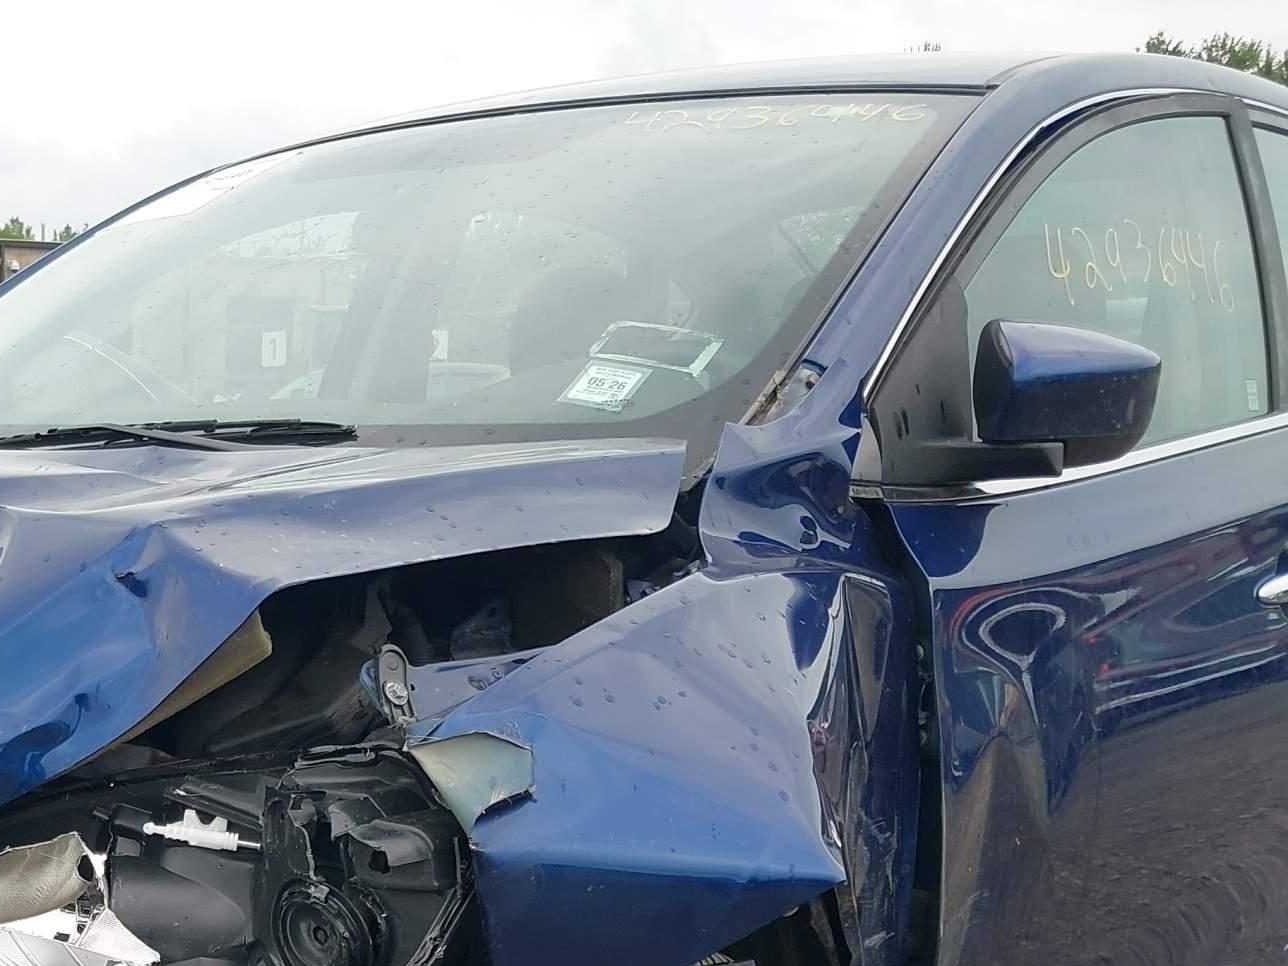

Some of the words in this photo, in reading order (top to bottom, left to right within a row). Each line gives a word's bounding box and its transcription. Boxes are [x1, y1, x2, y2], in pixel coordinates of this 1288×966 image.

[1044, 219, 1234, 313] 42936446
[268, 337, 277, 361] 1
[587, 376, 605, 387] 05
[608, 380, 628, 391] 26
